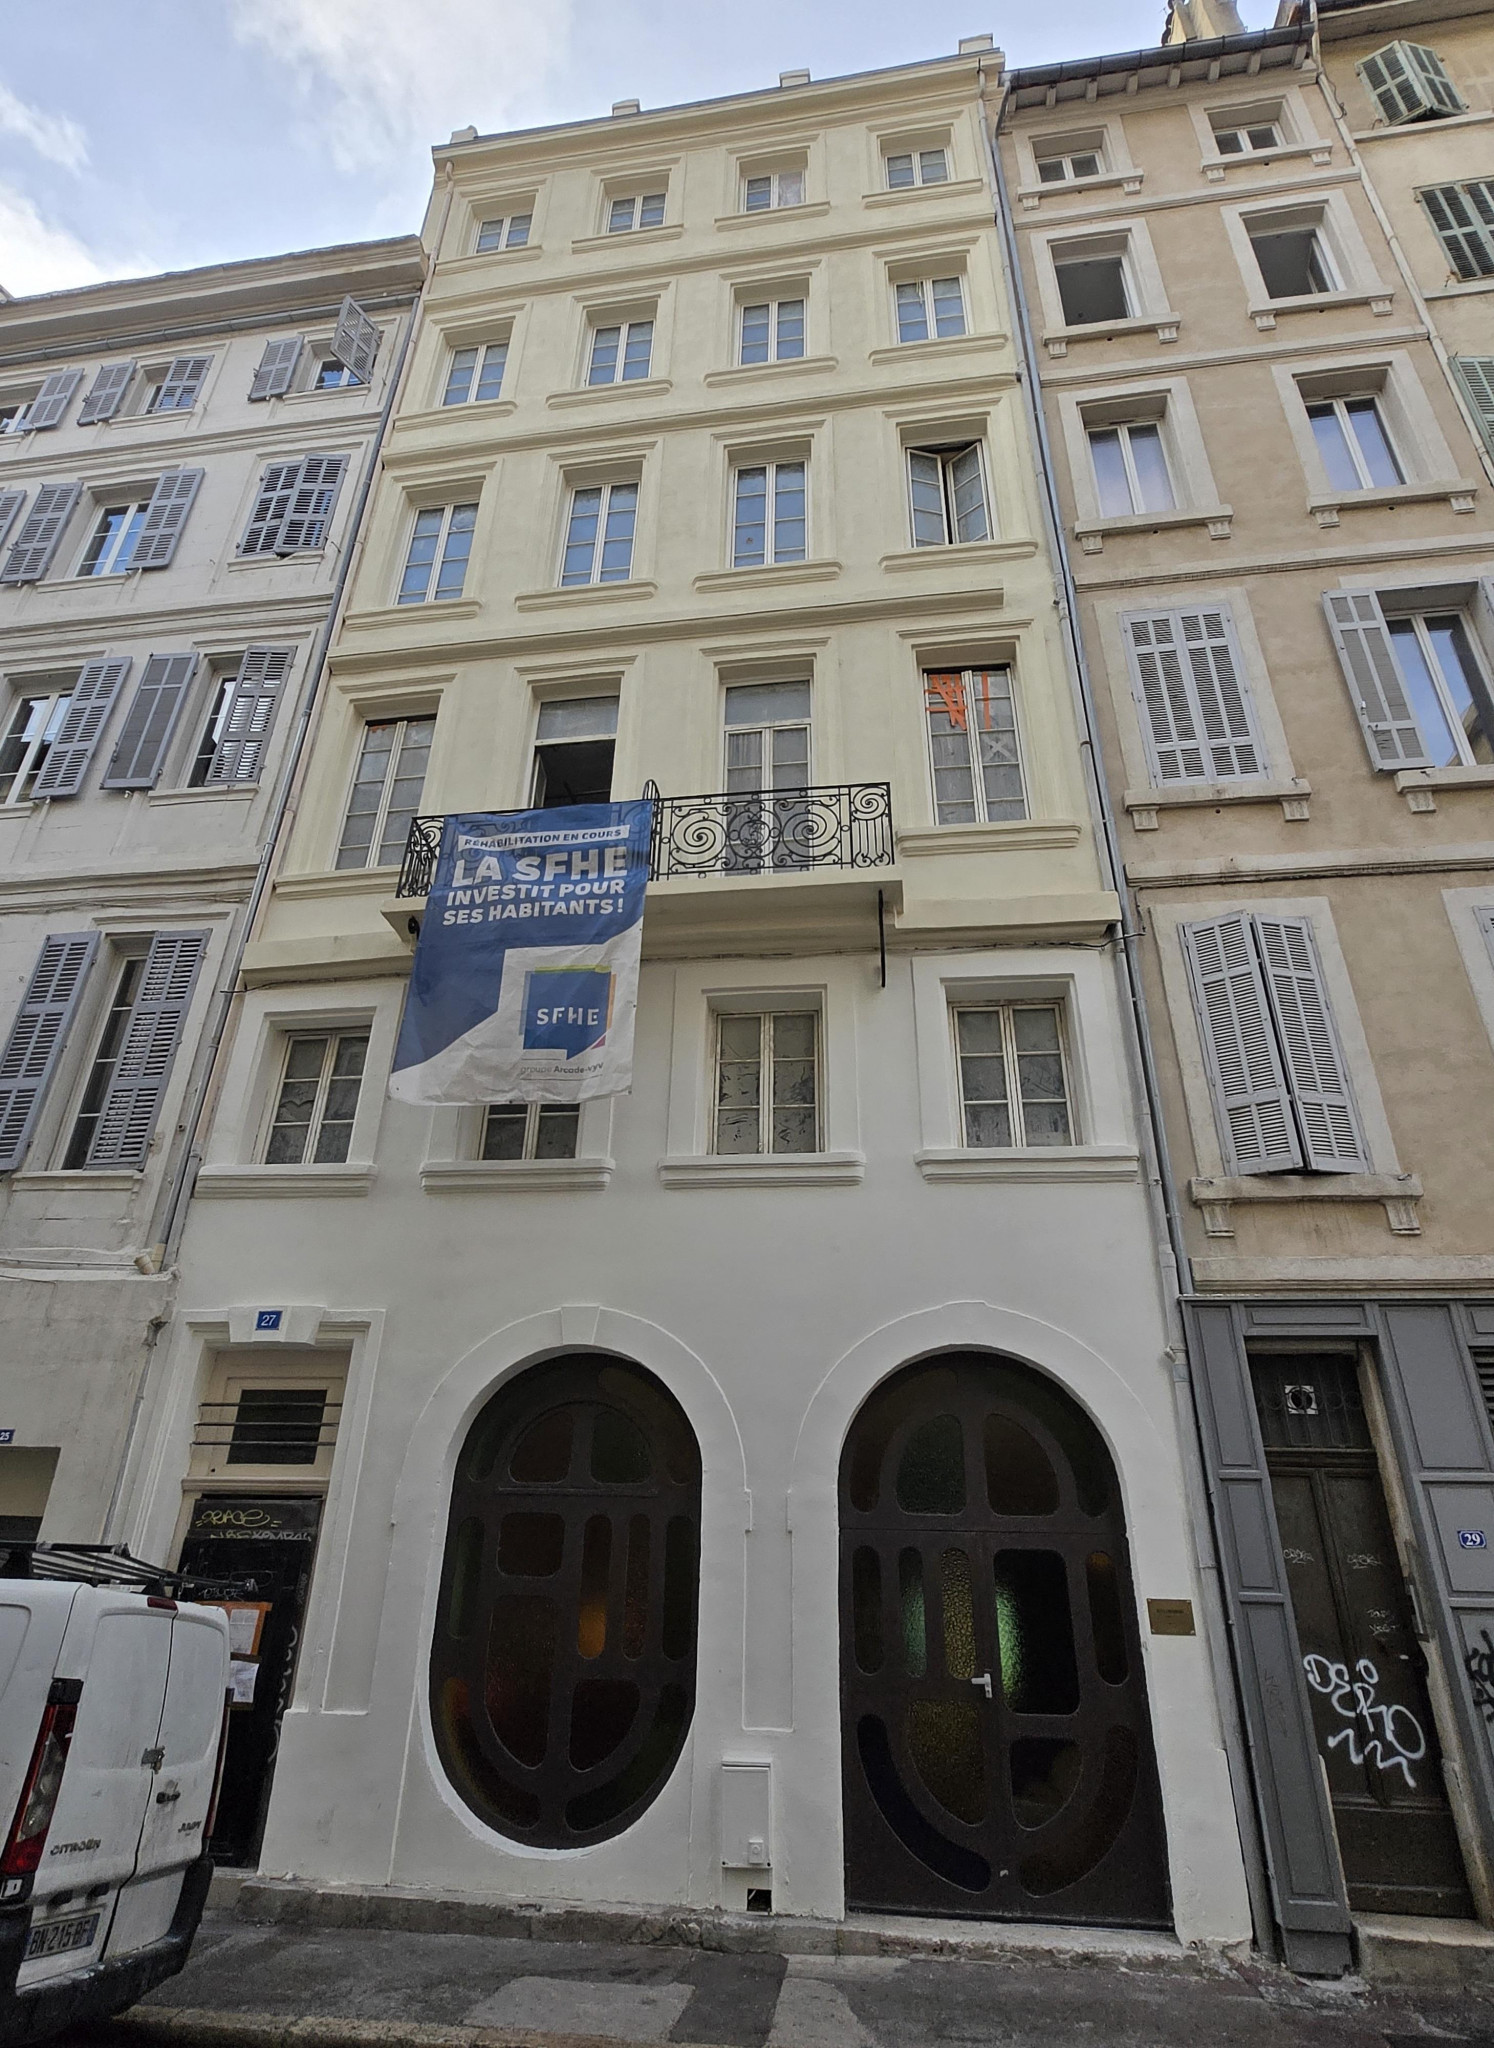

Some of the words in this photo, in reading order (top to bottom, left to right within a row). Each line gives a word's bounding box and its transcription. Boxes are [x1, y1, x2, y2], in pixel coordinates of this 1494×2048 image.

[563, 833, 579, 842] EN
[581, 829, 622, 840] COURS
[451, 855, 503, 888] LA
[512, 846, 628, 882] SFHE
[446, 884, 555, 907] INVESTIT
[558, 879, 626, 898] POUR
[442, 908, 484, 926] SES
[536, 1007, 599, 1026] SFHE
[261, 1314, 277, 1326] 27
[0, 1431, 10, 1441] 25
[1464, 1533, 1481, 1546] 29
